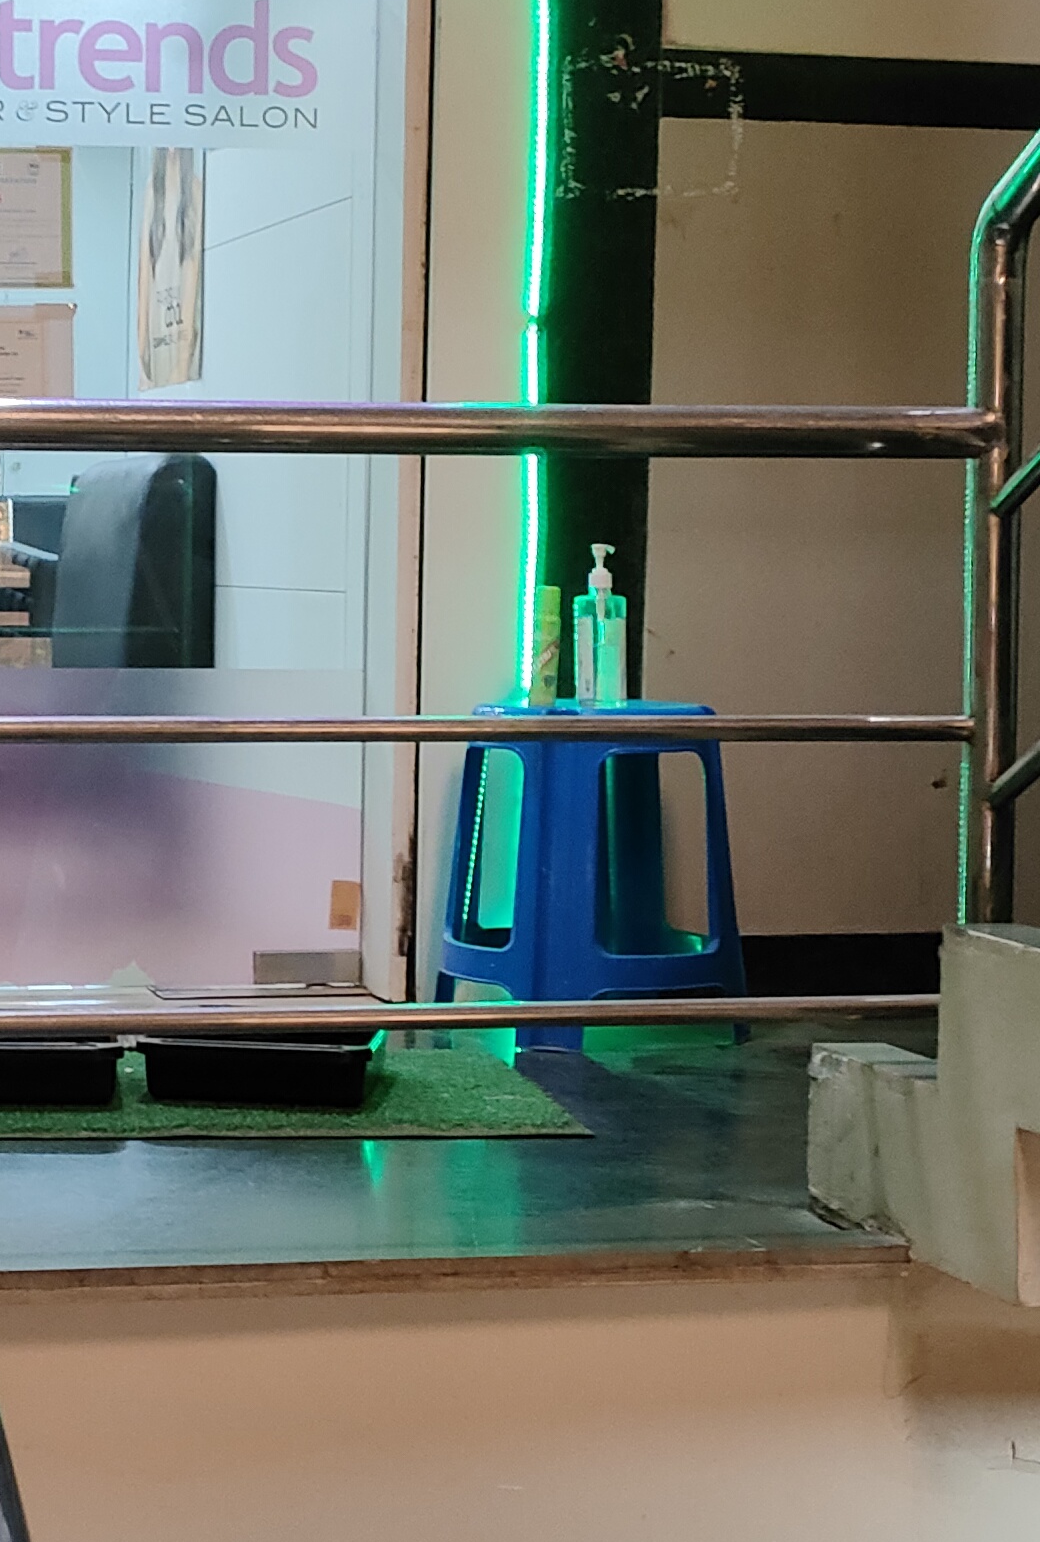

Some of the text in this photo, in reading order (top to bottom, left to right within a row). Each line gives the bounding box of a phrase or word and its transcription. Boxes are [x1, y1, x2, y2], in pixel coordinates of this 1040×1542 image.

[15, 99, 39, 123] &
[45, 100, 172, 126] STYLE
[184, 103, 318, 129] SALON
